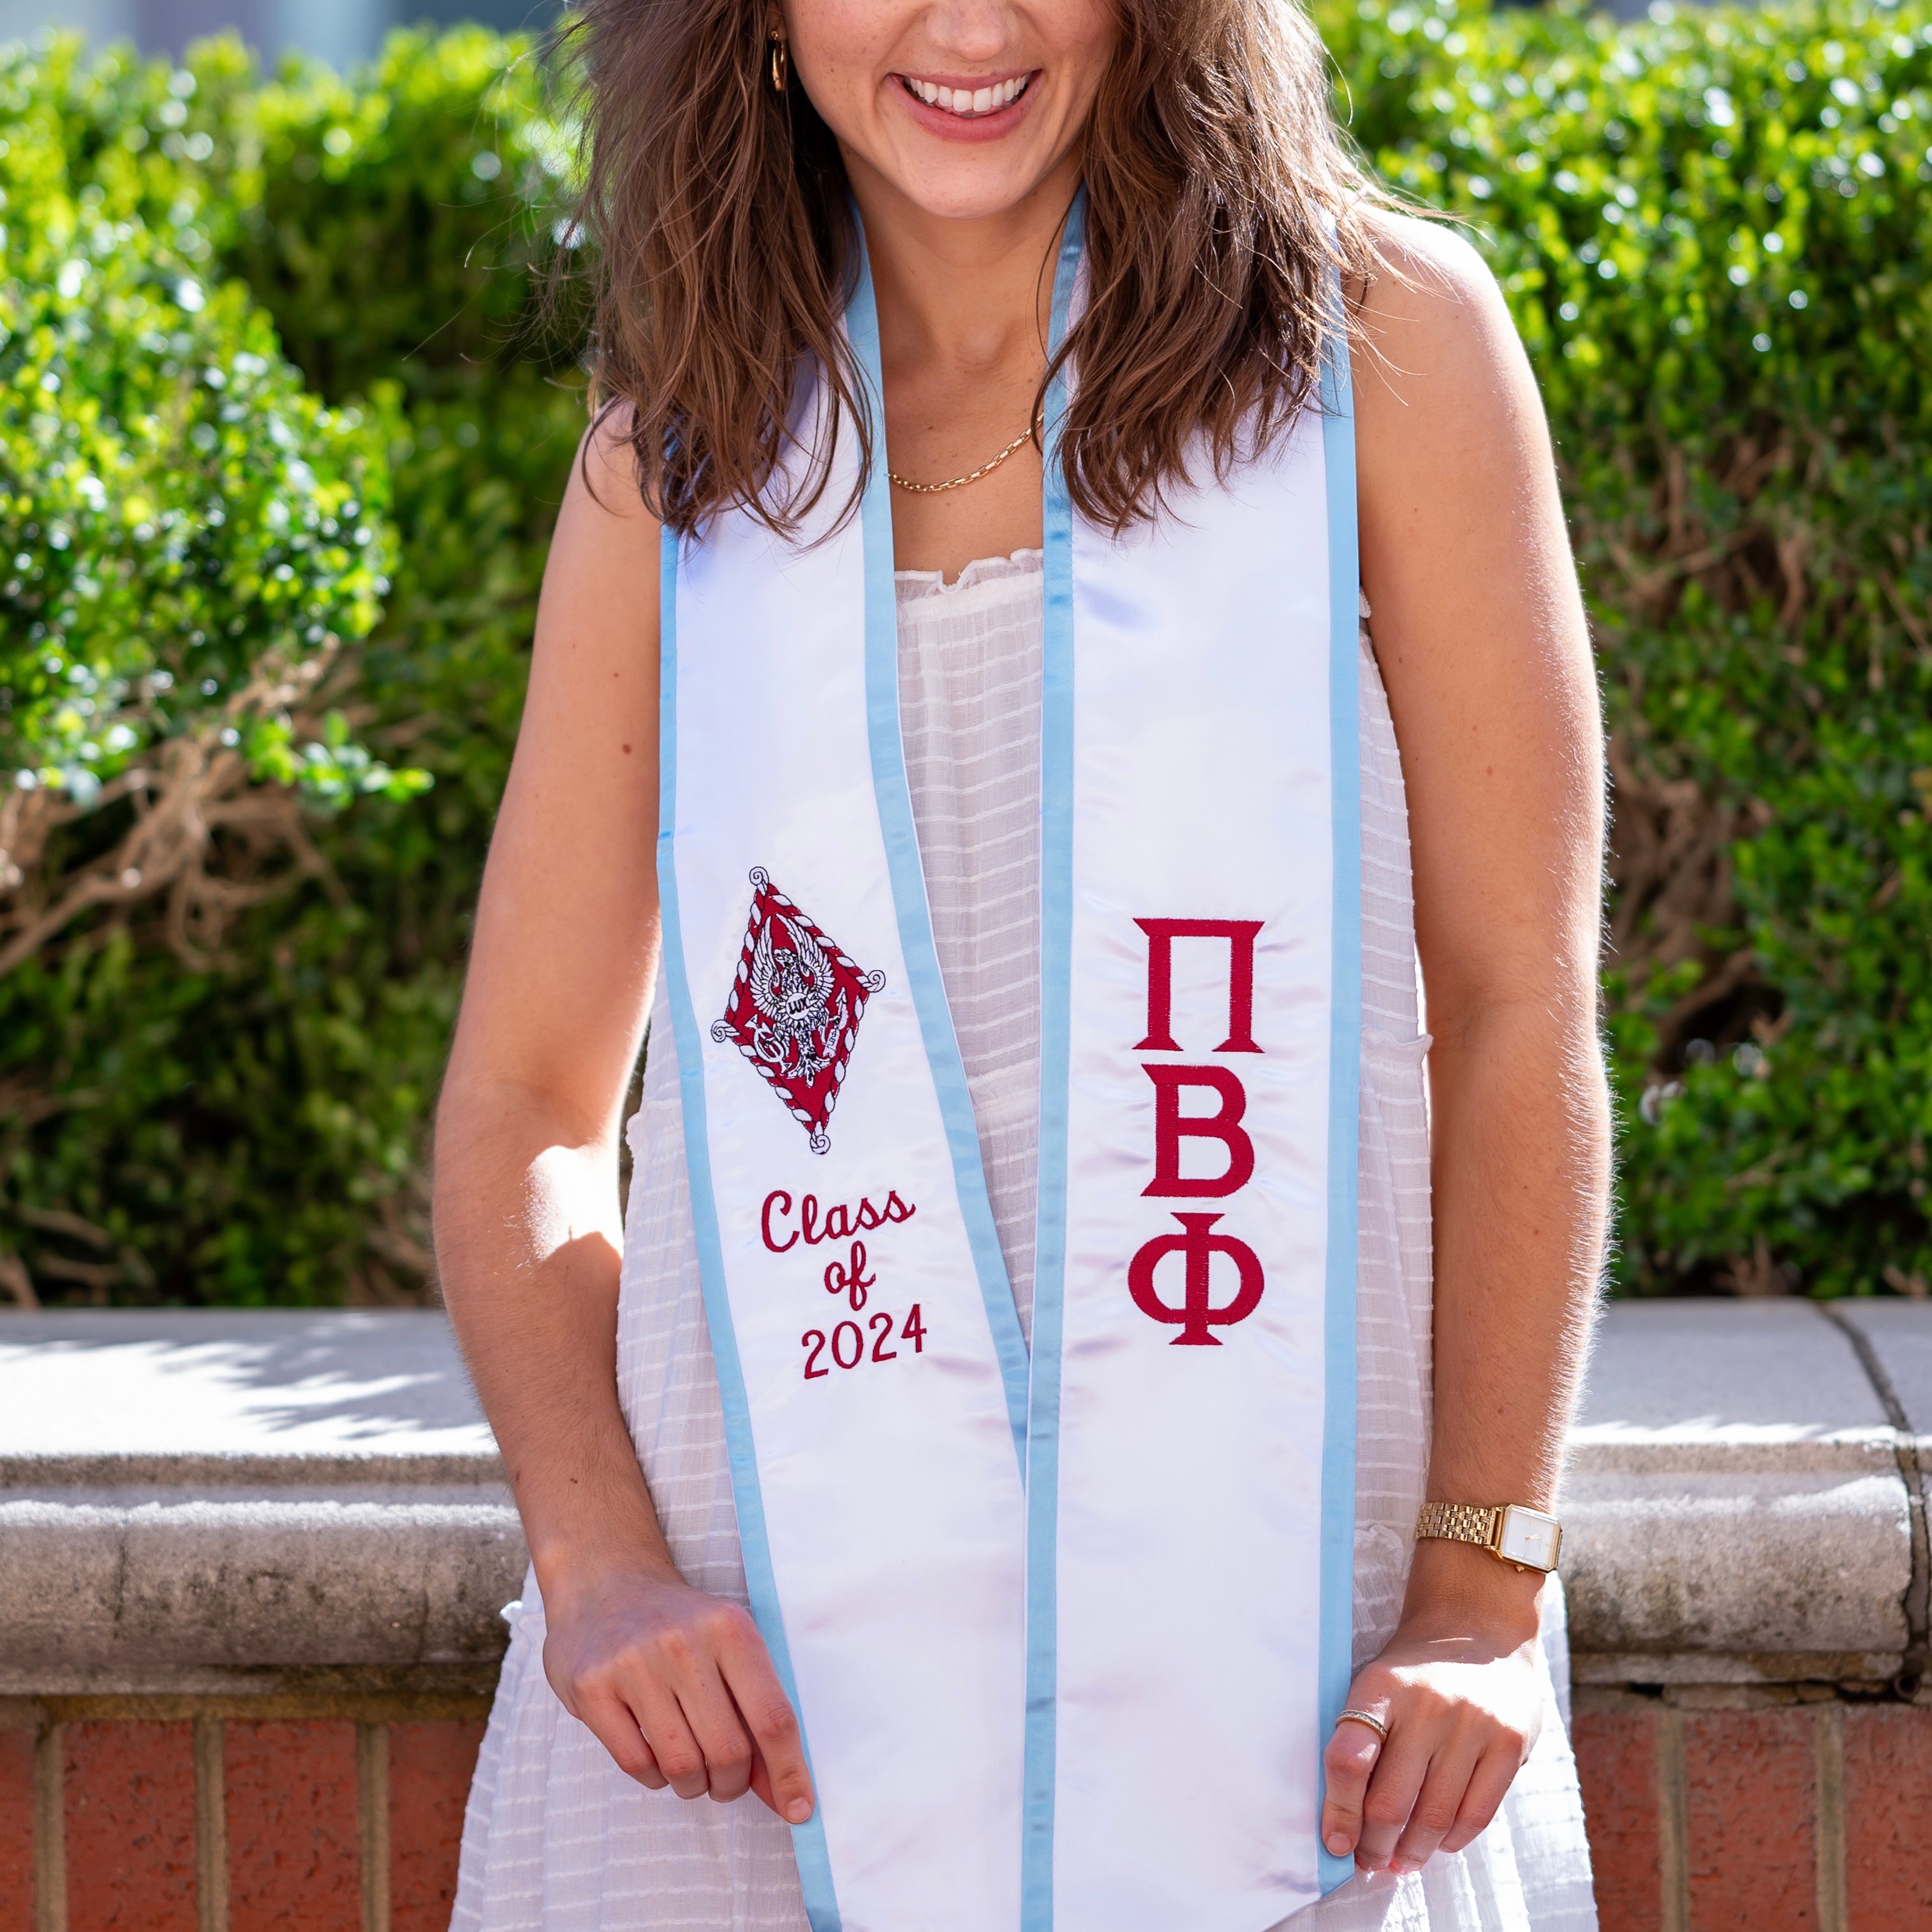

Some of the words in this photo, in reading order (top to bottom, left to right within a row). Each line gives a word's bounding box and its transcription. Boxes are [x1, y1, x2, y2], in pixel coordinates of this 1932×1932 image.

[761, 1190, 916, 1253] Class
[823, 1241, 876, 1311] of
[802, 1303, 927, 1380] 2024
